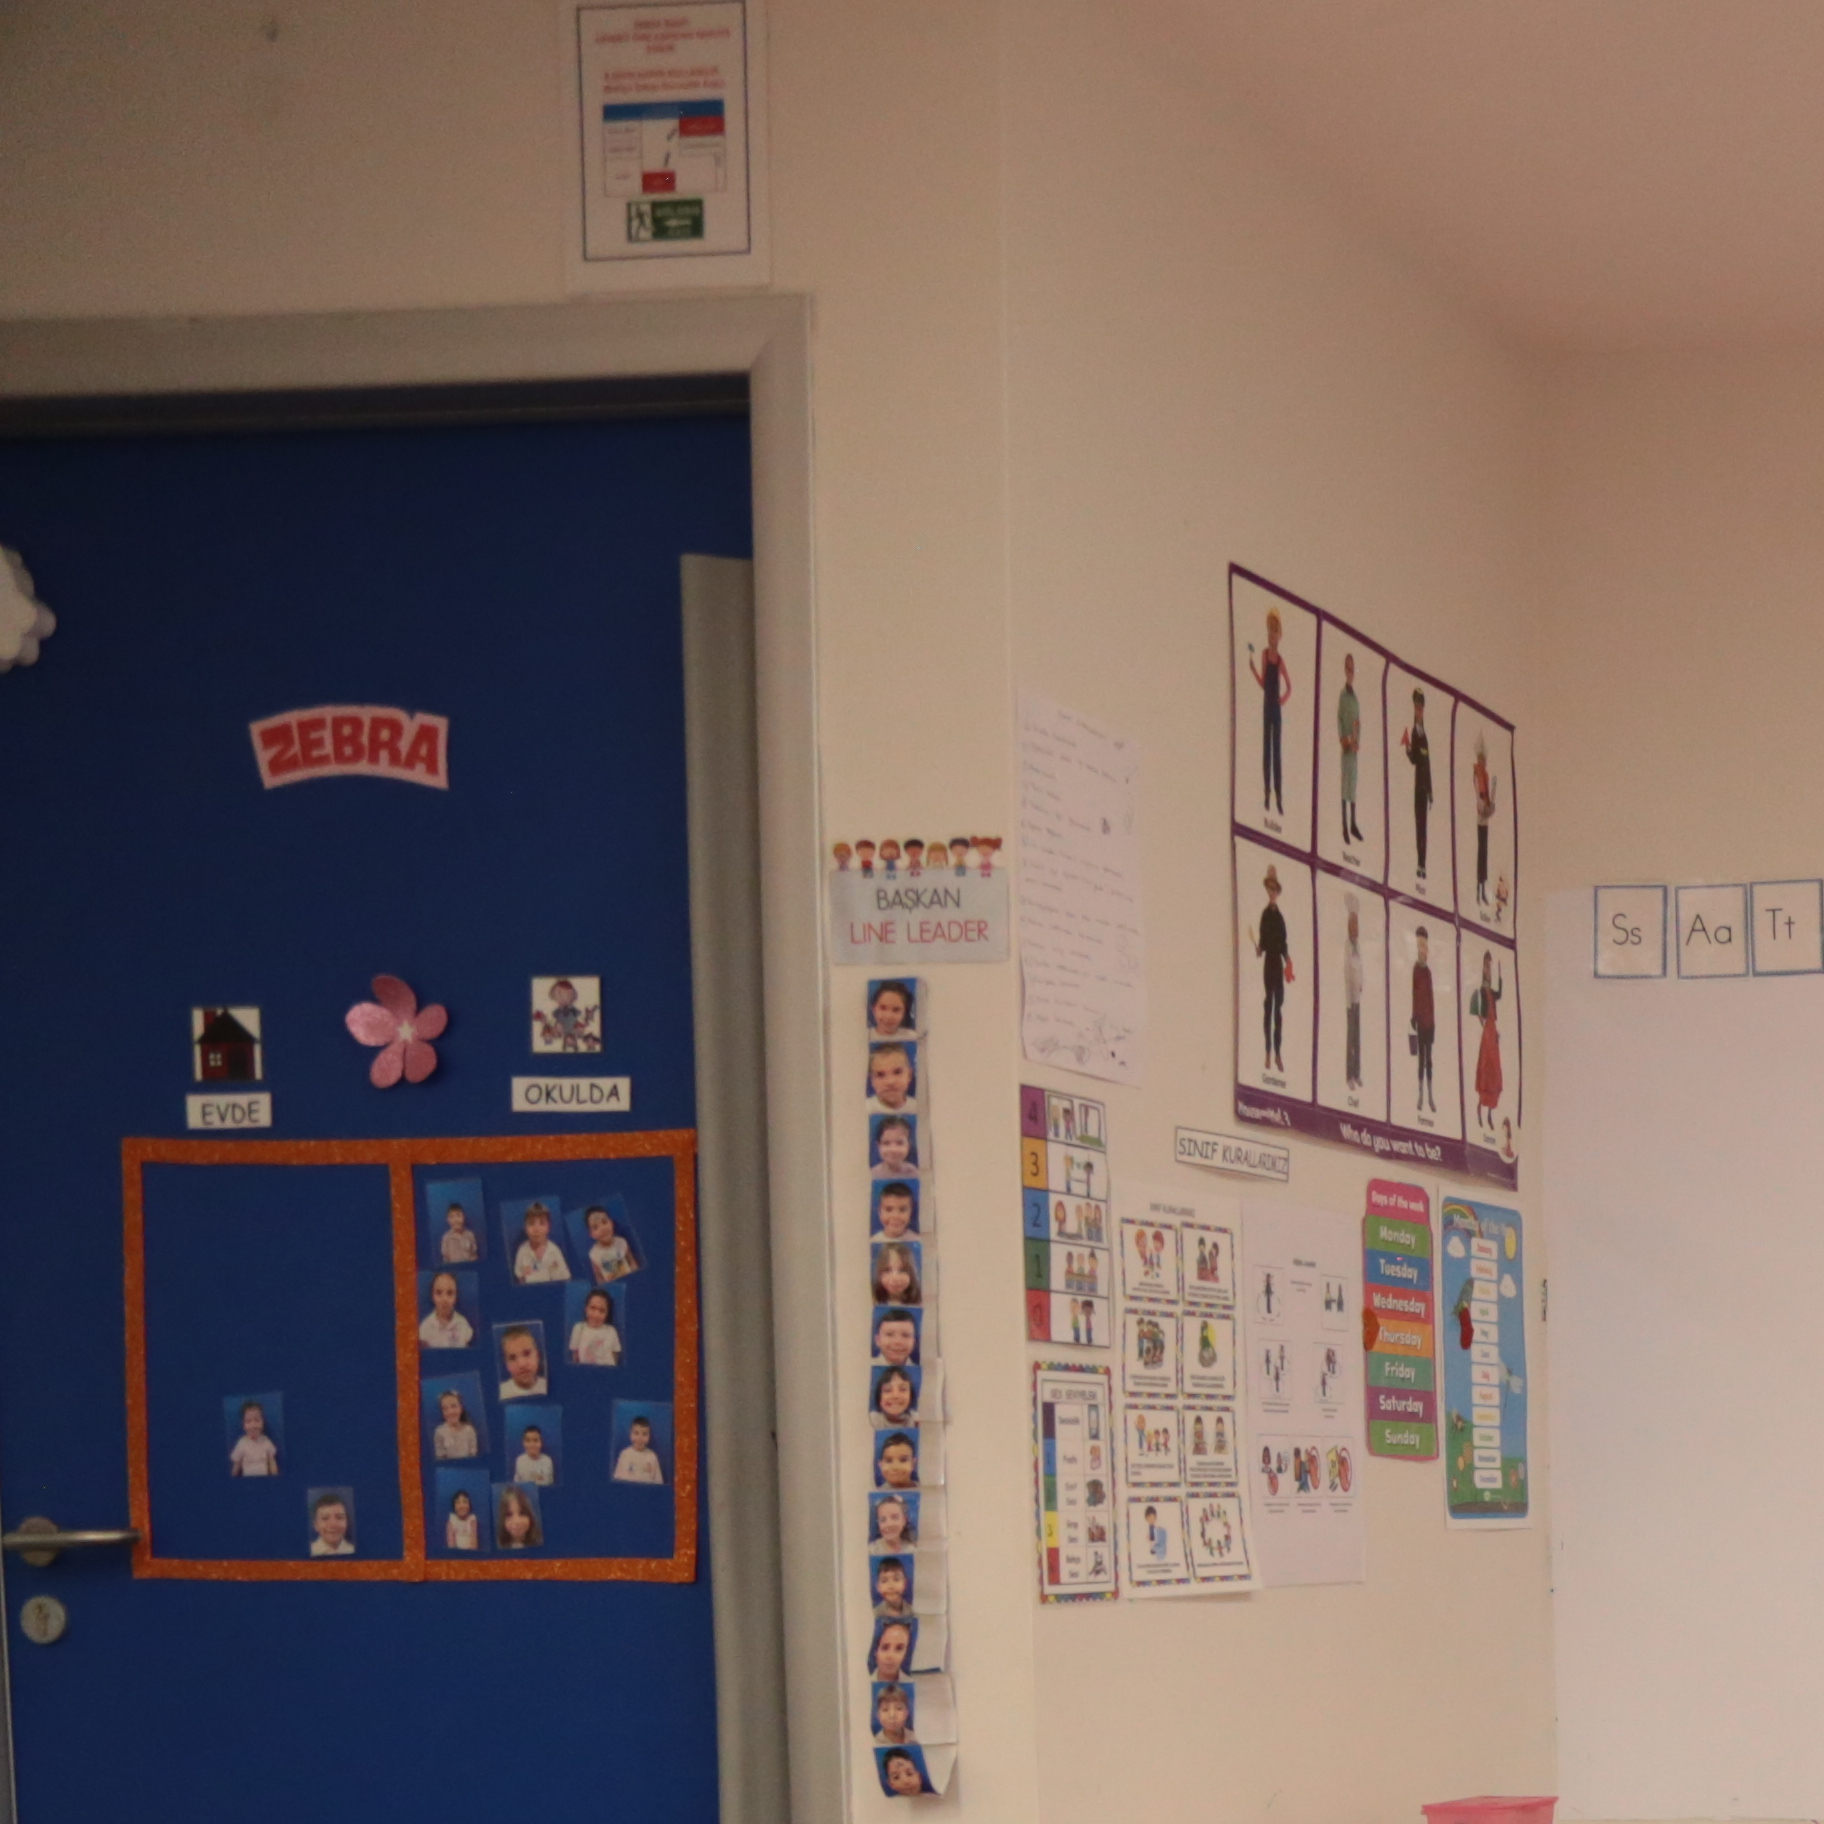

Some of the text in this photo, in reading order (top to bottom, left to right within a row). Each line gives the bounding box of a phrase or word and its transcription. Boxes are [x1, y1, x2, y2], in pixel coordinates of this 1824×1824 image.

[259, 715, 441, 778] ZEBRA
[876, 887, 961, 914] BAŞKAN
[849, 919, 990, 945] LINE LEADER
[1611, 913, 1643, 945] Ss
[1685, 914, 1733, 947] Aa
[1765, 907, 1796, 940] Tt
[523, 1082, 622, 1106] OKULDA
[201, 1101, 261, 1126] EVDE
[1178, 1137, 1219, 1160] SINIF
[1030, 1151, 1040, 1178] 3
[1031, 1202, 1042, 1228] 2
[1380, 1224, 1416, 1250] Monday
[1034, 1252, 1044, 1280] 1
[1379, 1258, 1418, 1284] Tuesday
[1372, 1291, 1426, 1318] Wednesday
[1379, 1325, 1423, 1350] Thursday
[1384, 1361, 1416, 1383] Friday
[1379, 1393, 1424, 1419] Saturday
[1384, 1428, 1421, 1450] Sunday
